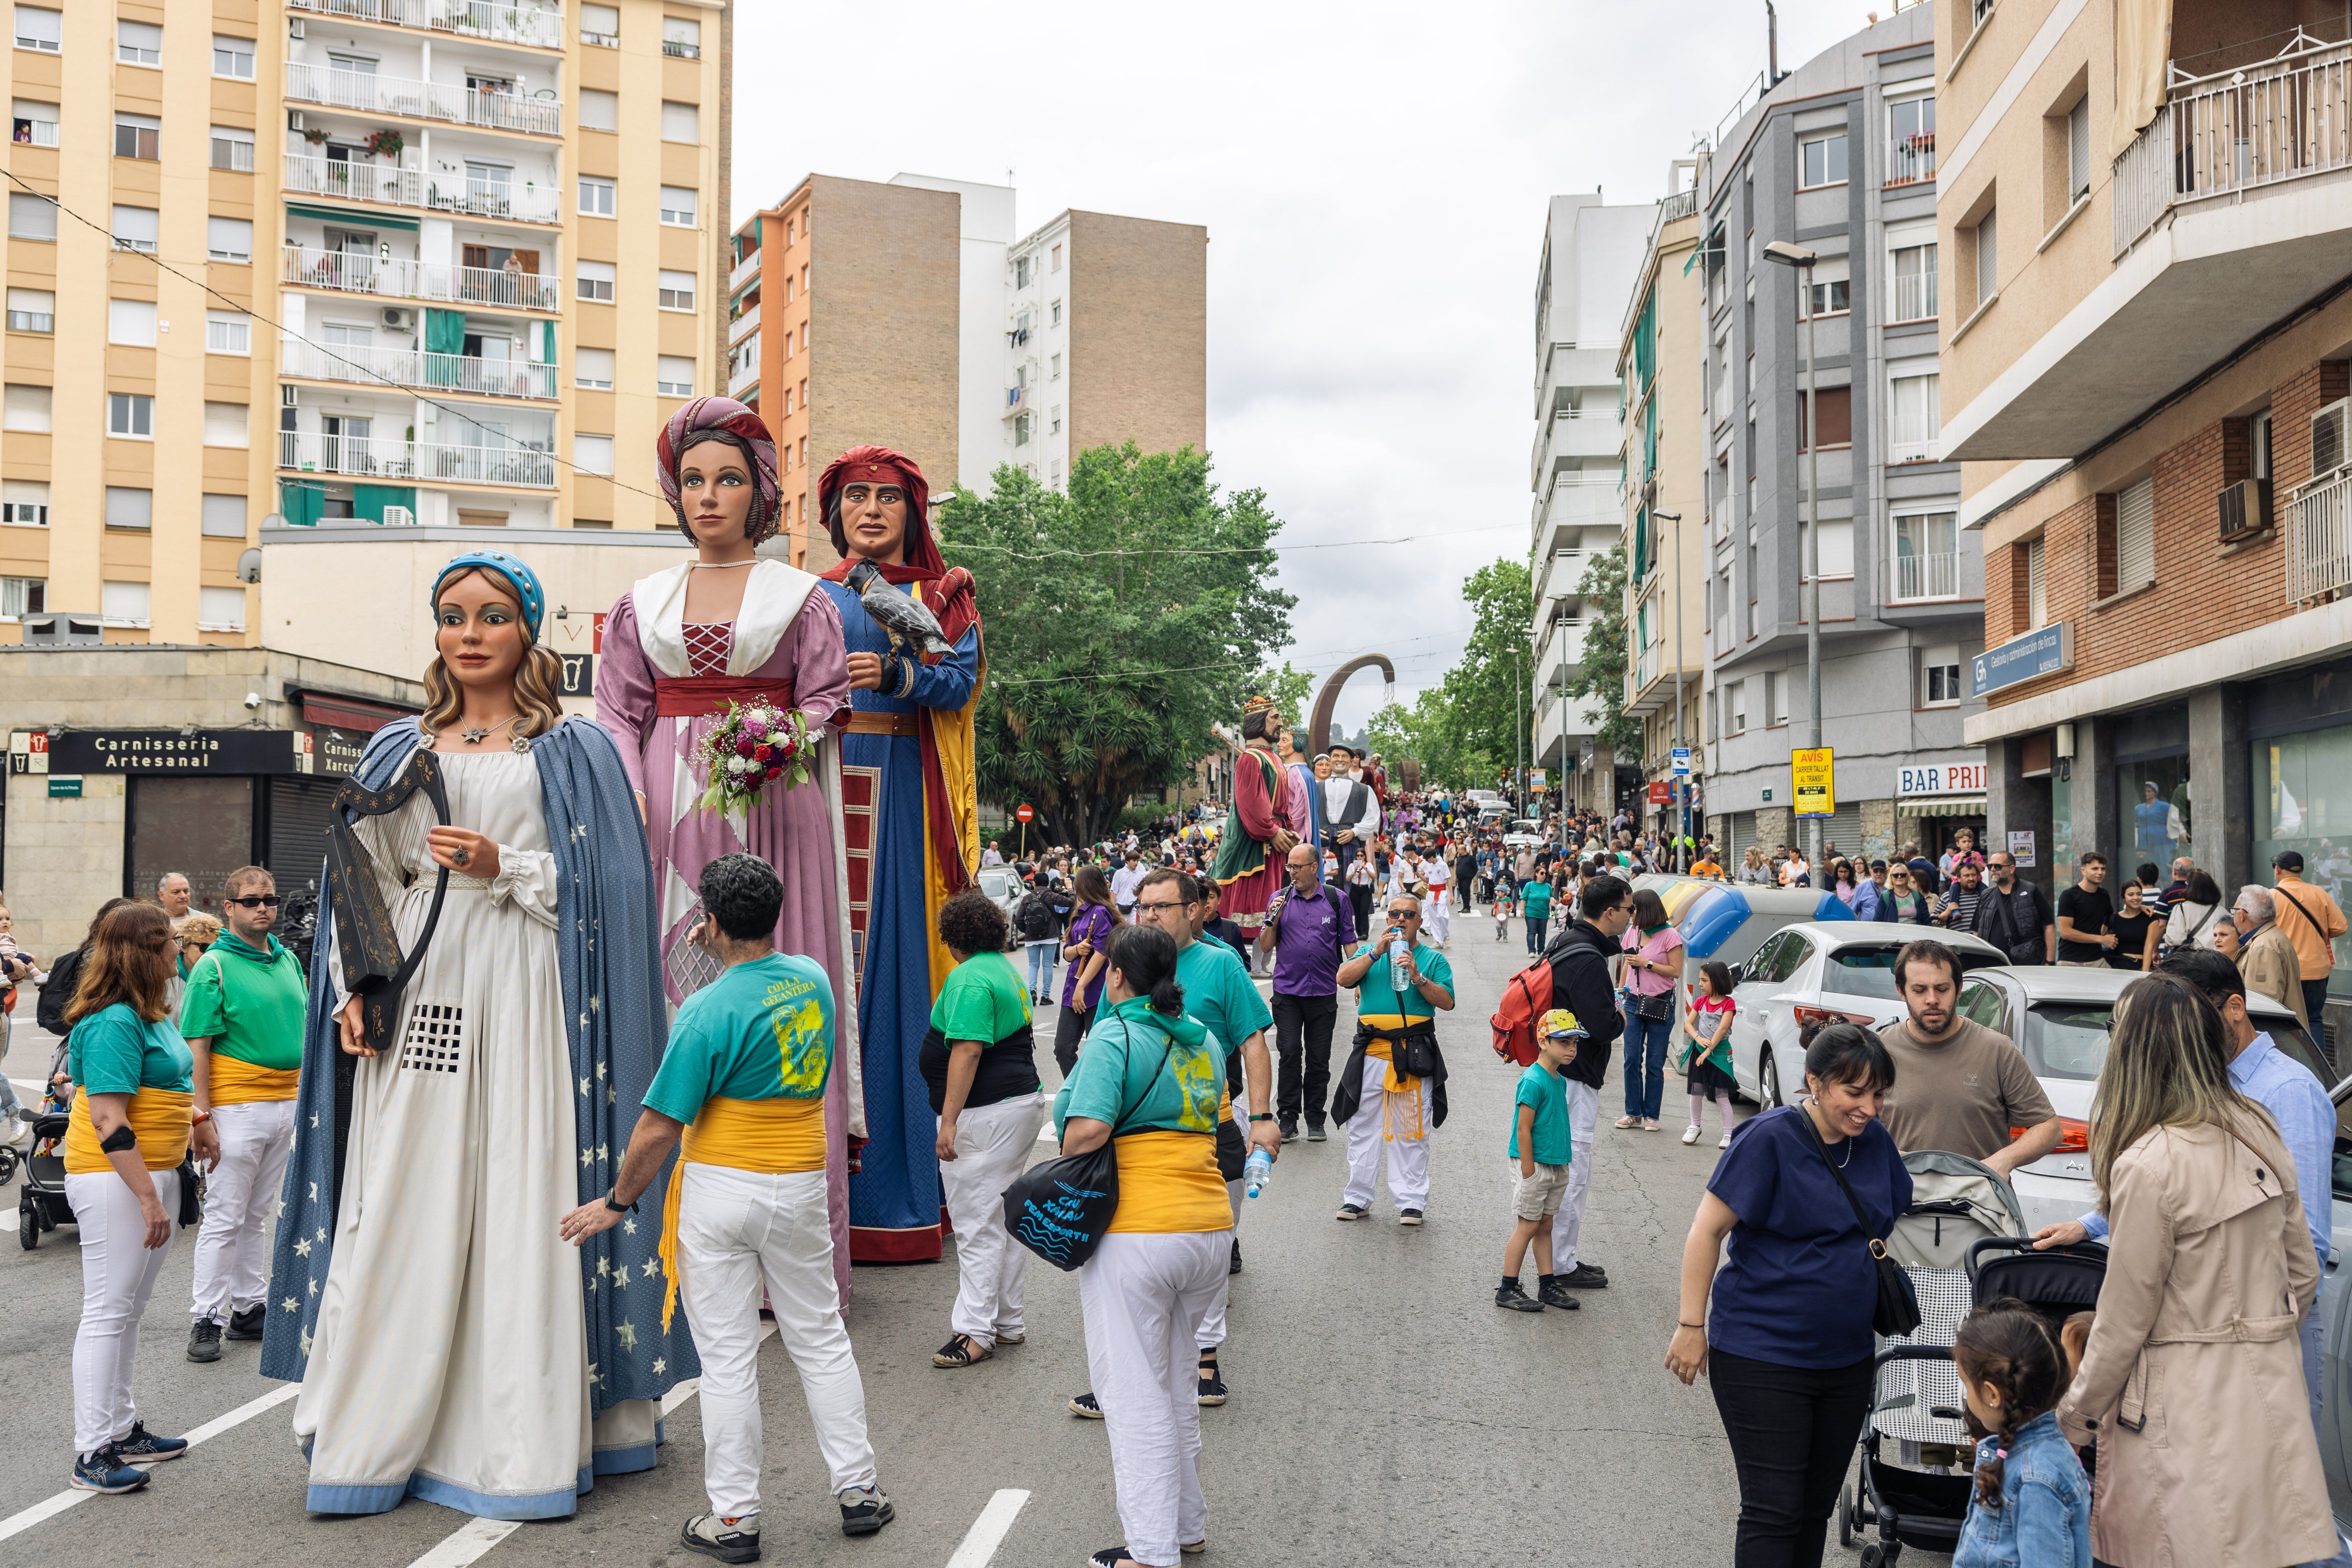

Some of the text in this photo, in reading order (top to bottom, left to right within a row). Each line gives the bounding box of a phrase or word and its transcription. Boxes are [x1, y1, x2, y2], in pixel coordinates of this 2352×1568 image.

[95, 736, 219, 751] Carnisseria
[105, 754, 208, 767] Artesanal
[1800, 751, 1823, 763] AVÍS
[1902, 769, 1939, 792] BAR
[767, 976, 800, 994] COLLA
[762, 980, 817, 1007] GEGANTERA
[2066, 1160, 2084, 1171] A1
[1024, 1199, 1089, 1242] FEM ESPORT!!
[718, 1533, 740, 1541] SALOMON
